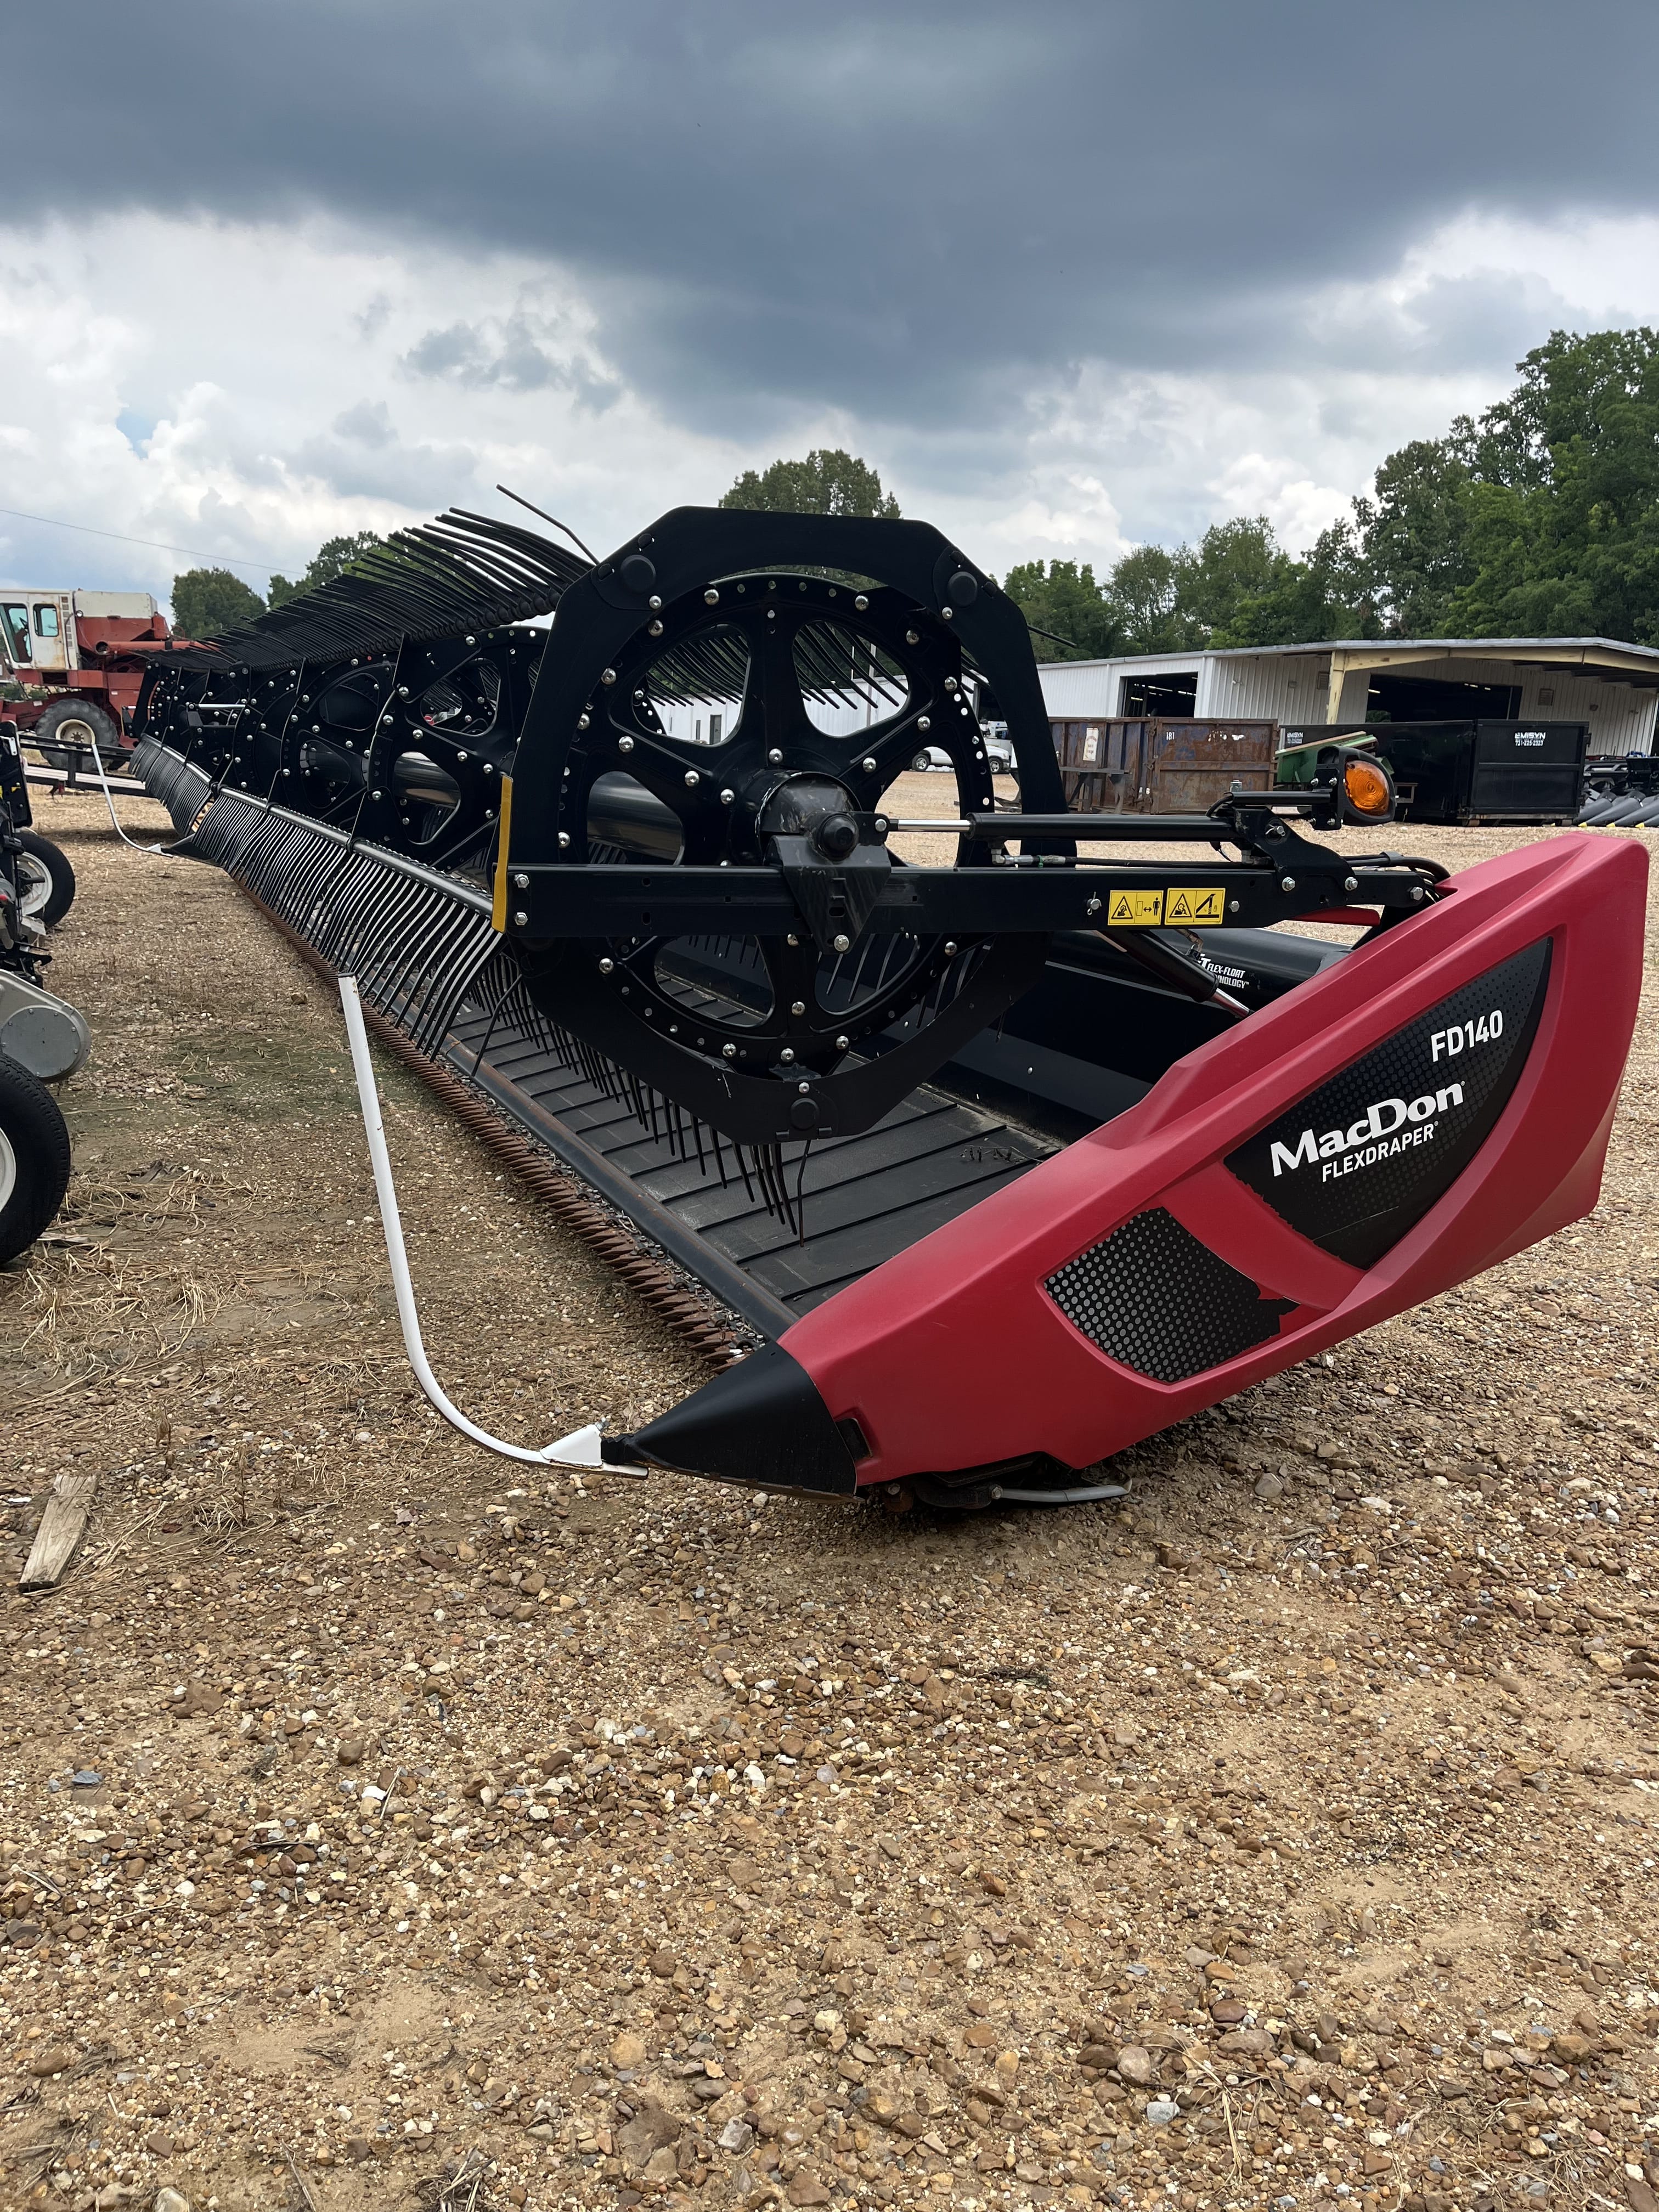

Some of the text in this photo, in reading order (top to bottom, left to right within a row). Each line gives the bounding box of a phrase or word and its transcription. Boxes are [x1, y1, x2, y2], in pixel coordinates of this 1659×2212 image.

[1166, 731, 1175, 741] 181
[1207, 963, 1246, 979] FLEX-FLOAT
[1431, 1010, 1503, 1062] FD140
[1270, 1083, 1464, 1177] MacDon
[1322, 1123, 1435, 1182] FLEXDRAPER
